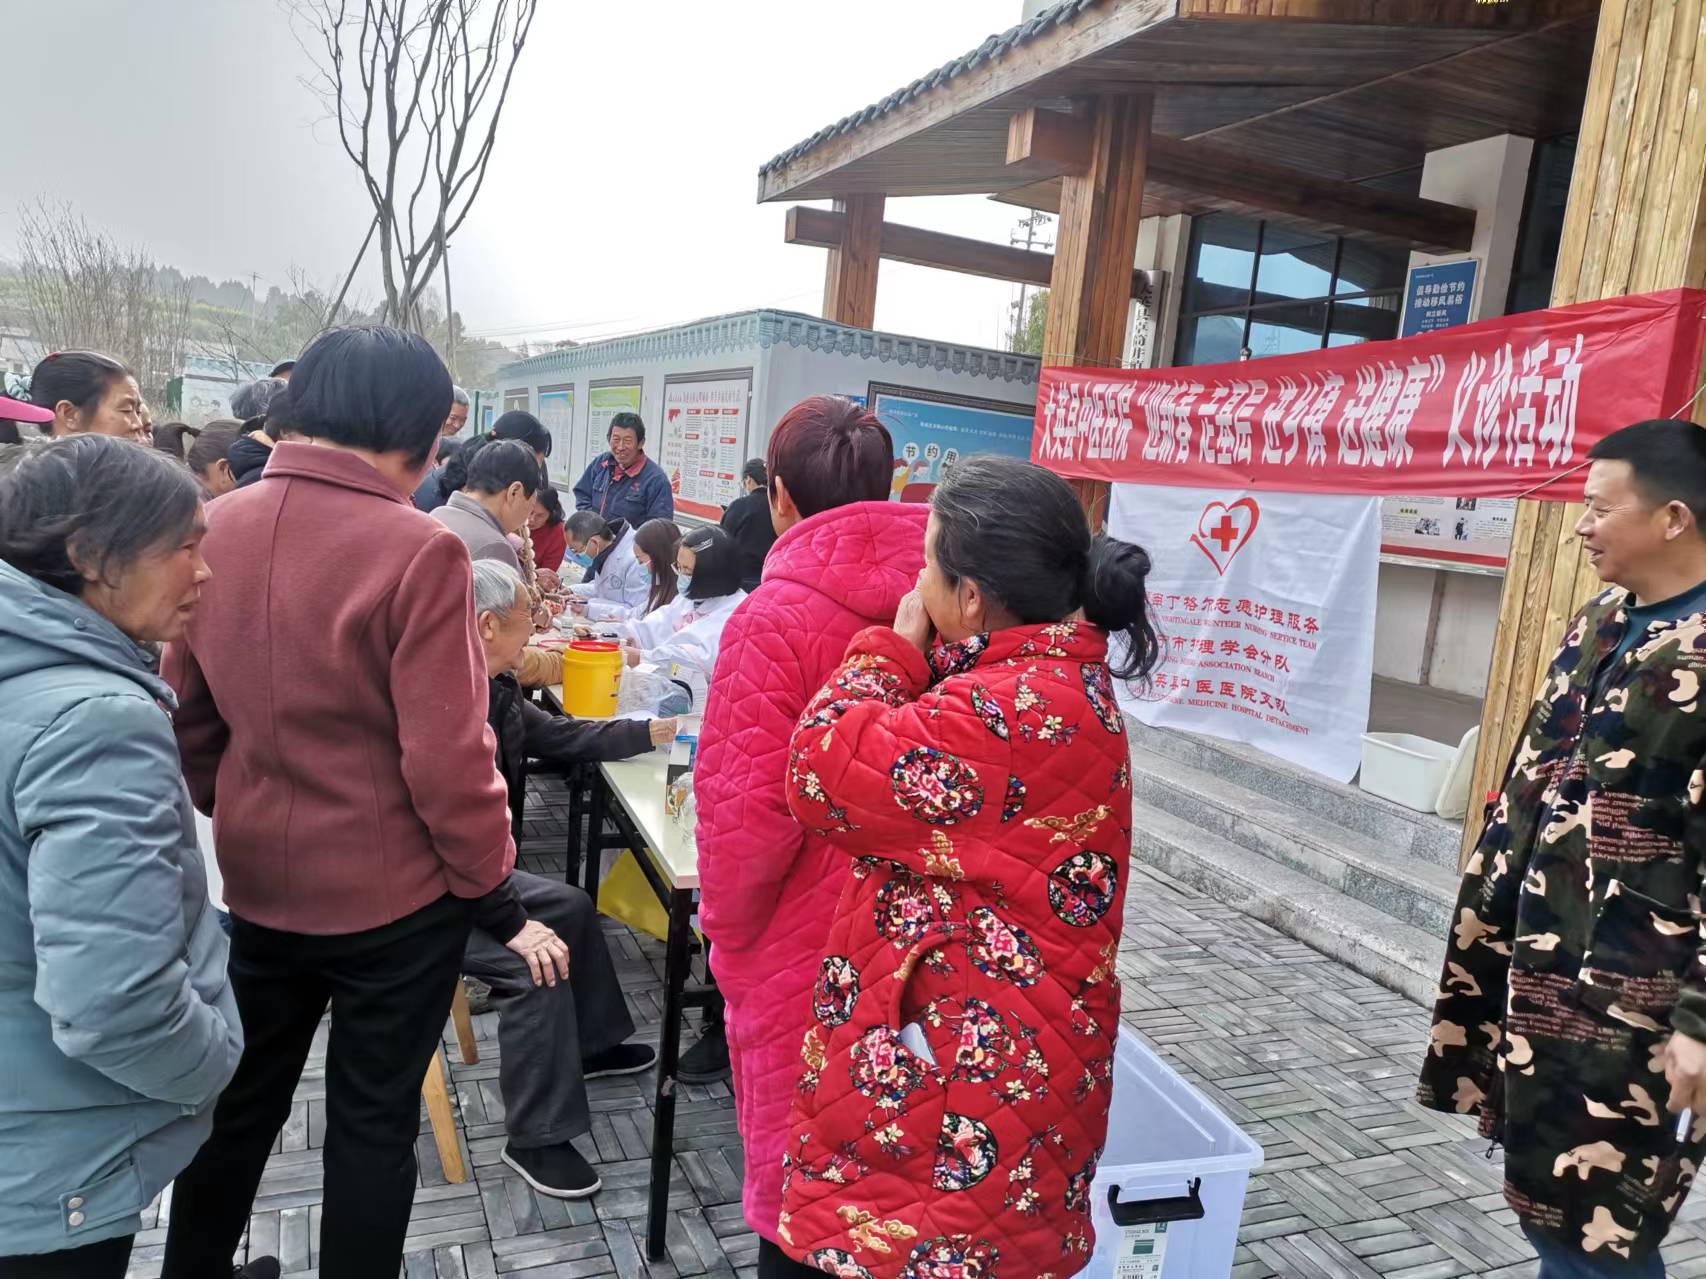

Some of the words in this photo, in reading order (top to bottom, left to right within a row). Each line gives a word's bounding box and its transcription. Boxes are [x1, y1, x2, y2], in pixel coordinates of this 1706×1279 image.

[1039, 380, 1137, 461] 大英县中医医院
[1262, 370, 1345, 467] 进乡镇
[1443, 334, 1584, 469] 义诊活动
[1188, 698, 1228, 710] MEDICINE
